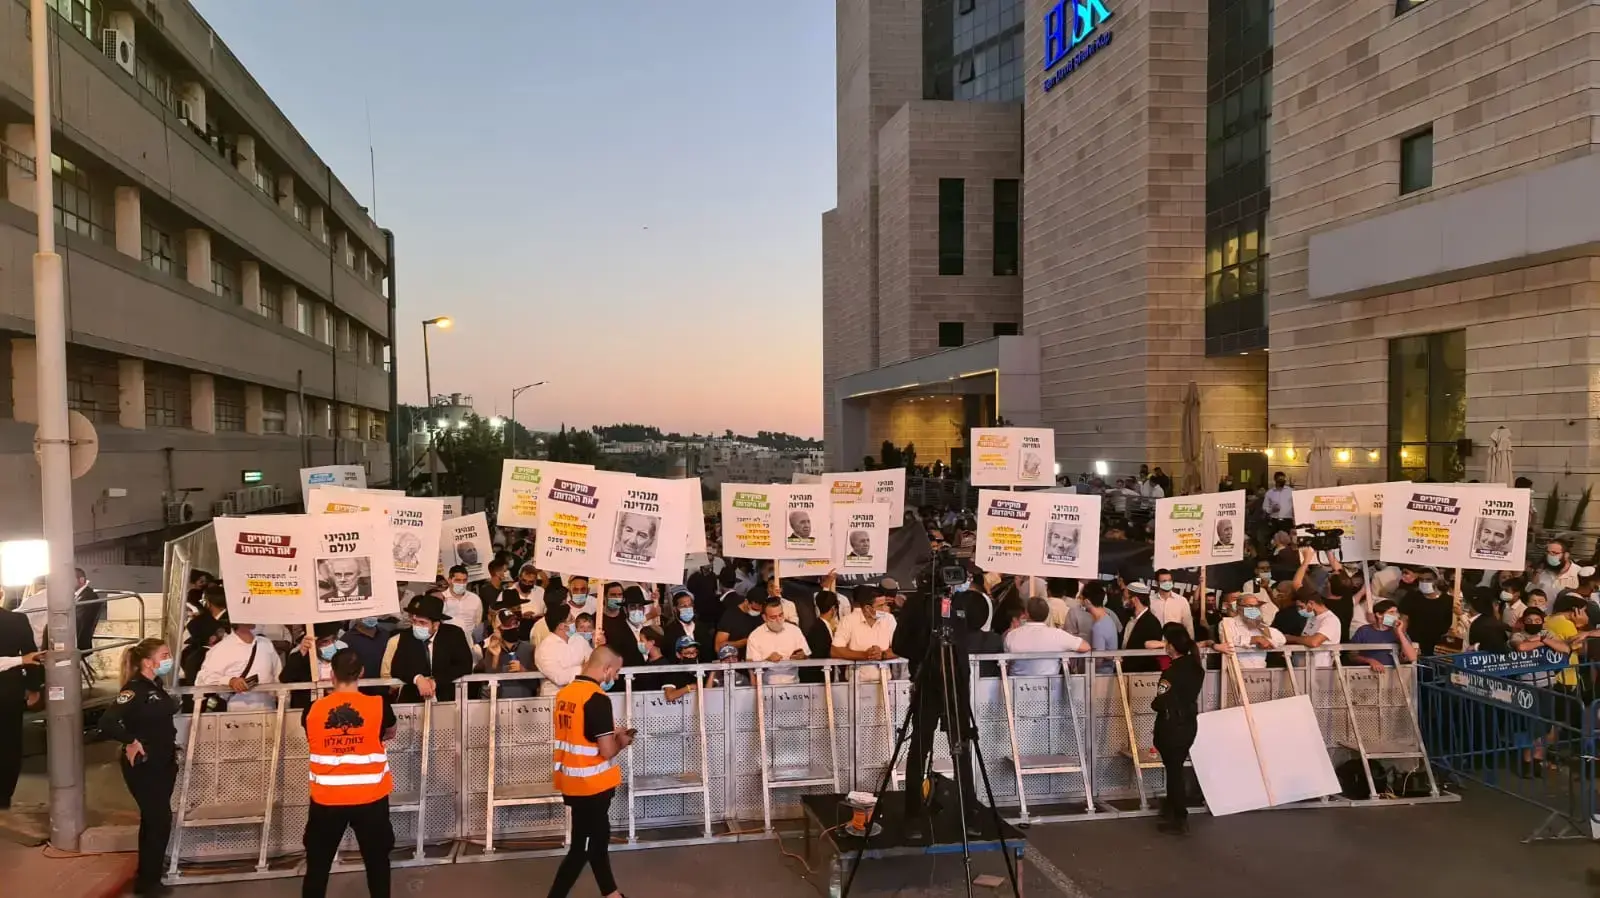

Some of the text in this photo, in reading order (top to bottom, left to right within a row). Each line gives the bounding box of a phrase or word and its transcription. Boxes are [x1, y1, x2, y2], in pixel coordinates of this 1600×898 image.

[560, 481, 588, 492] מוקירים
[627, 490, 658, 501] מנהיגי
[789, 494, 812, 502] מנהיגי
[1420, 494, 1450, 504] מוקירים
[581, 497, 594, 505] את
[1485, 500, 1514, 508] מנהיגי
[624, 500, 660, 512] המדינה
[1053, 504, 1079, 512] מנהיגי
[396, 510, 422, 518] מנהיגי
[1050, 512, 1080, 521] המדינה
[1482, 508, 1514, 516] המדינה
[393, 518, 423, 527] המדינה
[247, 534, 282, 544] מוקירים
[324, 531, 360, 542] מנהיגי
[455, 532, 478, 541] המדינה
[277, 547, 291, 556] את
[329, 542, 357, 553] עולם
[324, 736, 365, 748] צוות אלון
